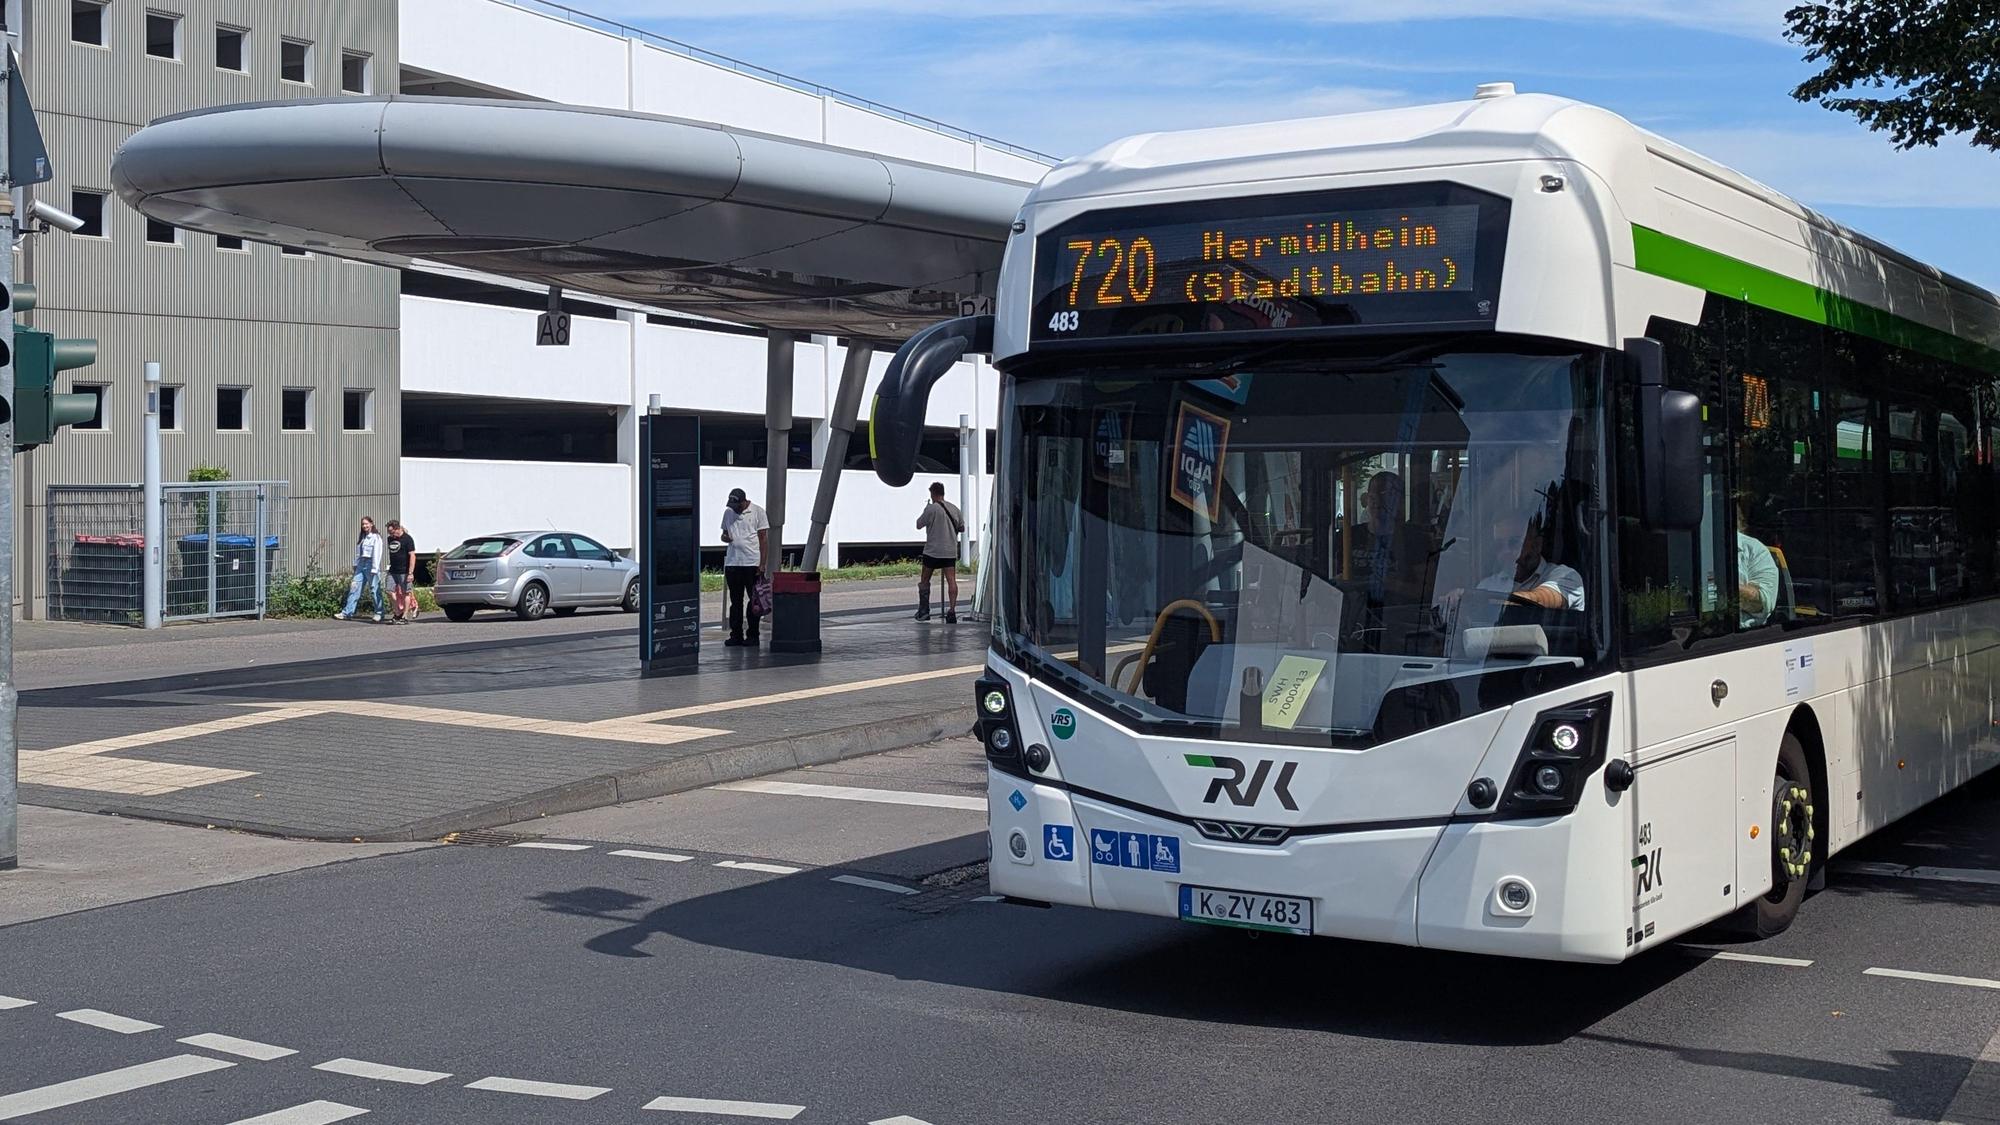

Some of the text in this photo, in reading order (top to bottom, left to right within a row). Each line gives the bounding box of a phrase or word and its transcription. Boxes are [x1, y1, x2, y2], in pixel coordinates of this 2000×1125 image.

[1204, 216, 1437, 260] Hermülheim
[1067, 237, 1156, 306] 720
[1185, 257, 1458, 303] (Stadtbahn)
[539, 315, 568, 344] A8
[1048, 311, 1080, 333] 483
[1269, 678, 1288, 704] SWH
[1278, 670, 1308, 716] 7000413
[1050, 713, 1070, 725] VRS
[1639, 822, 1652, 846] 483
[1199, 892, 1214, 916] K
[1228, 895, 1256, 920] ZY
[1260, 898, 1301, 925] 483
